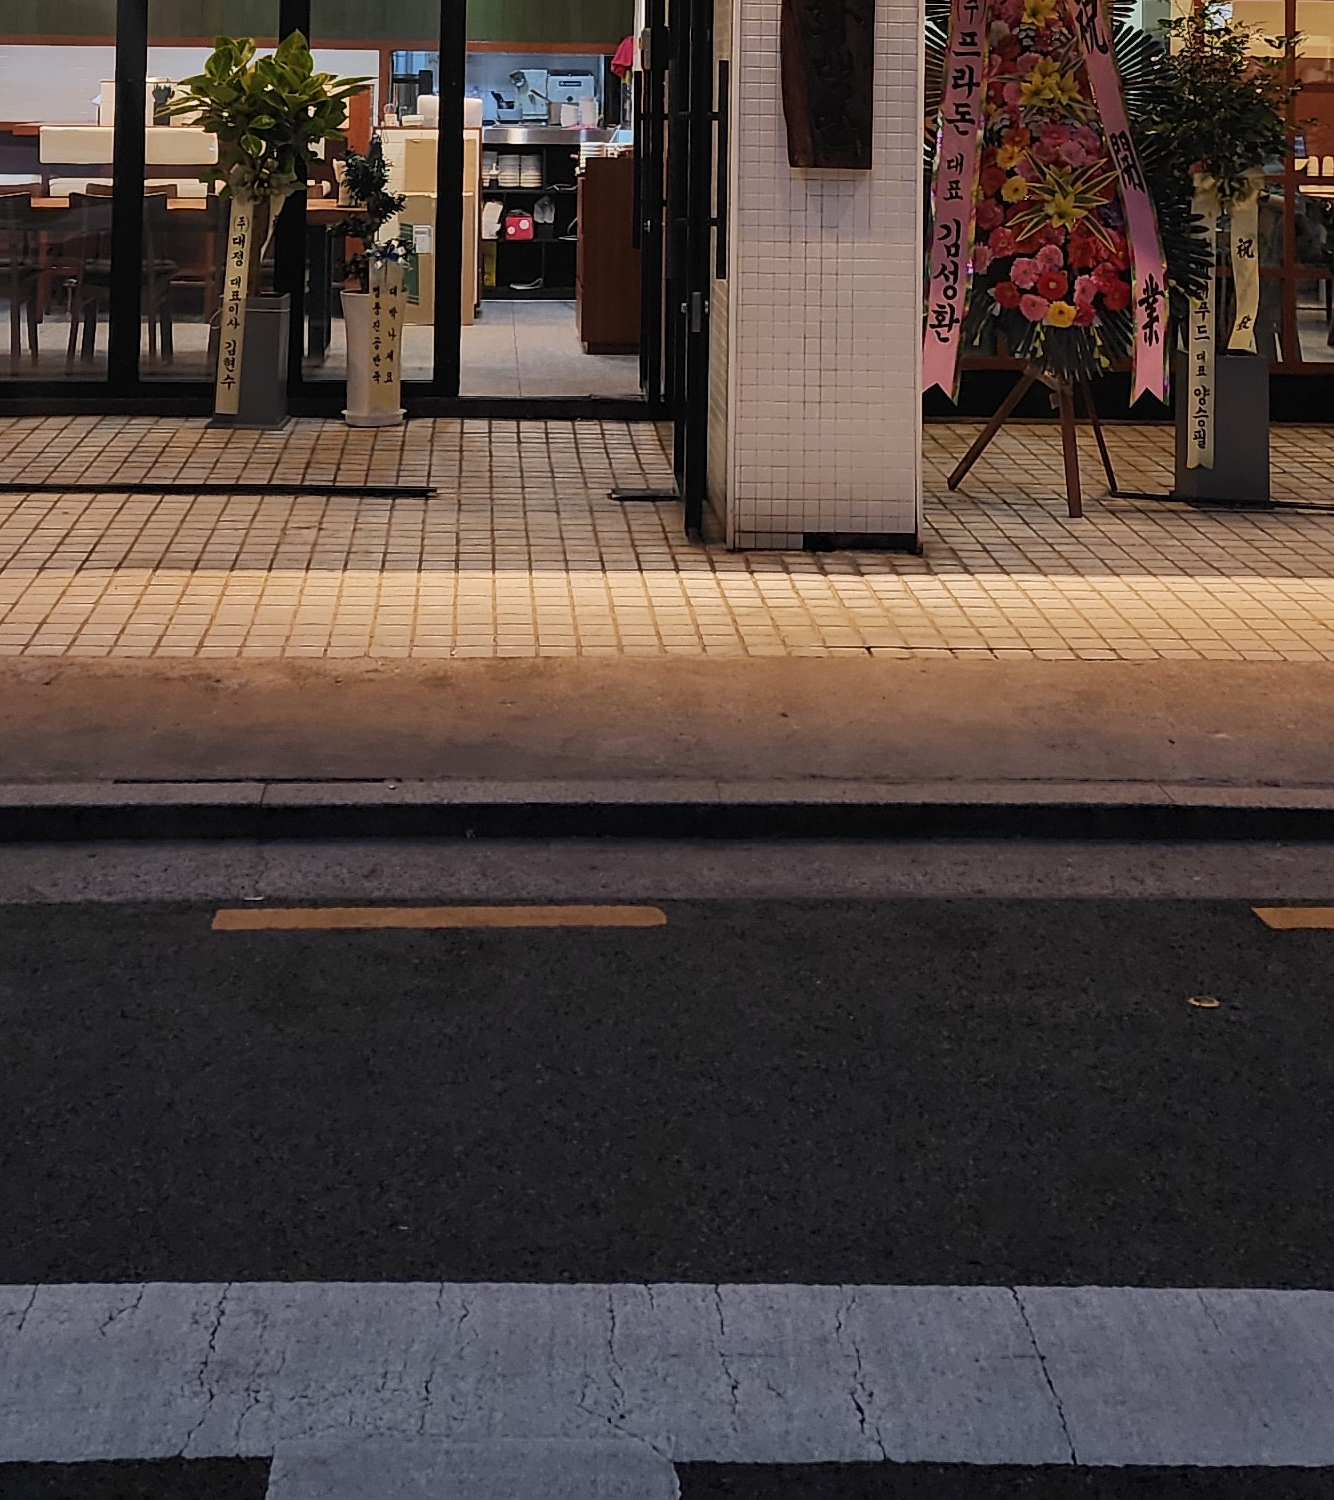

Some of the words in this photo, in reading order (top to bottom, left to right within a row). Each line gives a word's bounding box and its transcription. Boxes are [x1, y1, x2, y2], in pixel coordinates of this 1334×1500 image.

[942, 152, 966, 202] 대표
[227, 275, 243, 331] 대표이사
[927, 218, 964, 344] 김성환
[384, 284, 398, 384] 대박나세요
[220, 339, 237, 390] 김현수
[1195, 351, 1208, 377] 대표
[1192, 385, 1211, 449] 양승필
